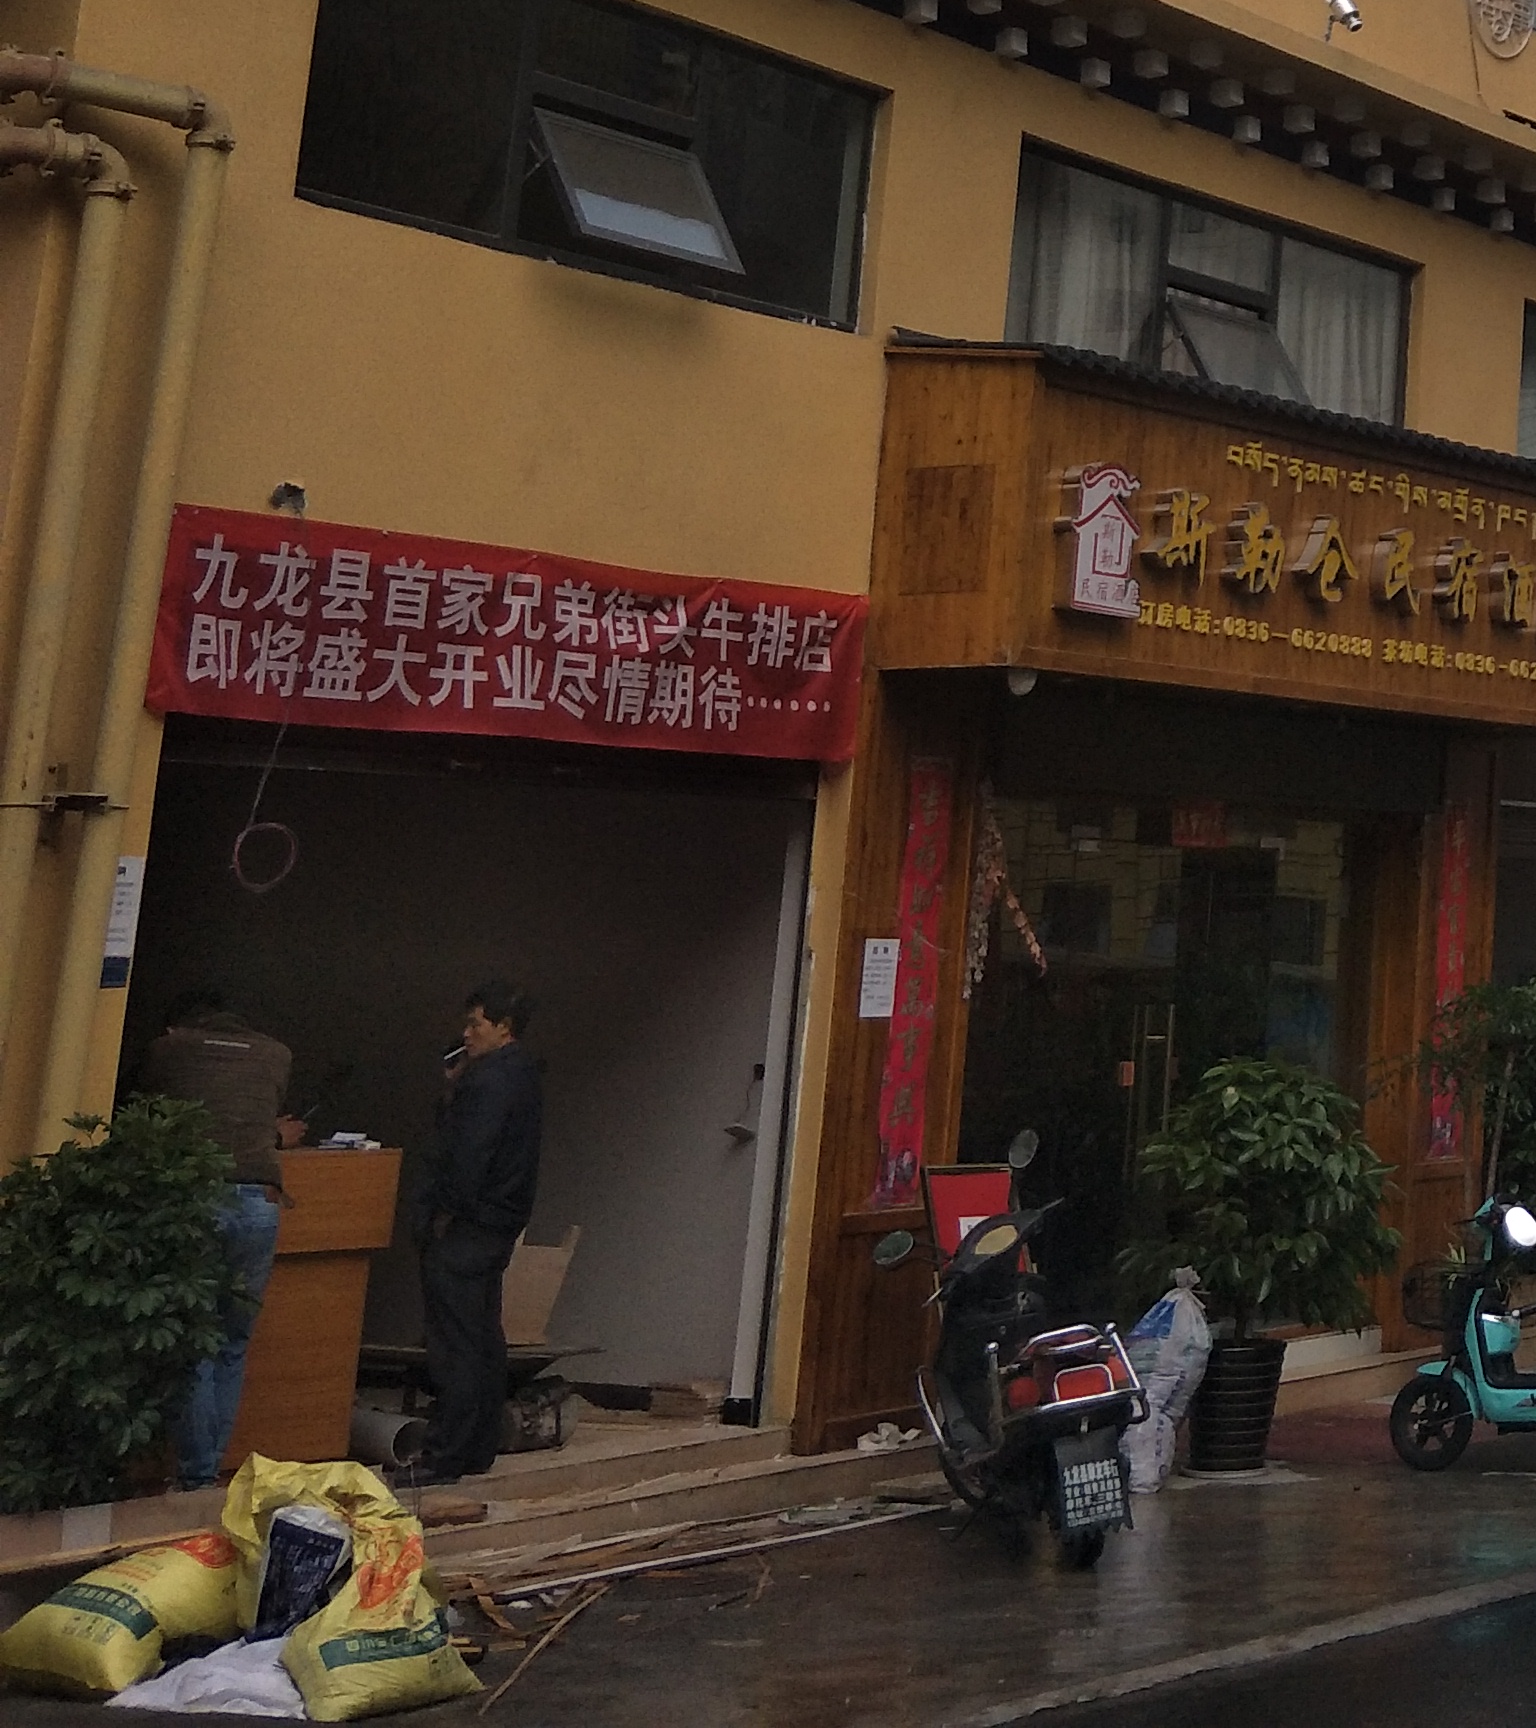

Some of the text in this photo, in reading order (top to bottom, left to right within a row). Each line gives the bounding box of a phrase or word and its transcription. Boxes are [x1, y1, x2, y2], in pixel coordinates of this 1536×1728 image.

[192, 534, 839, 676] 九龙县首家兄弟街头牛排店
